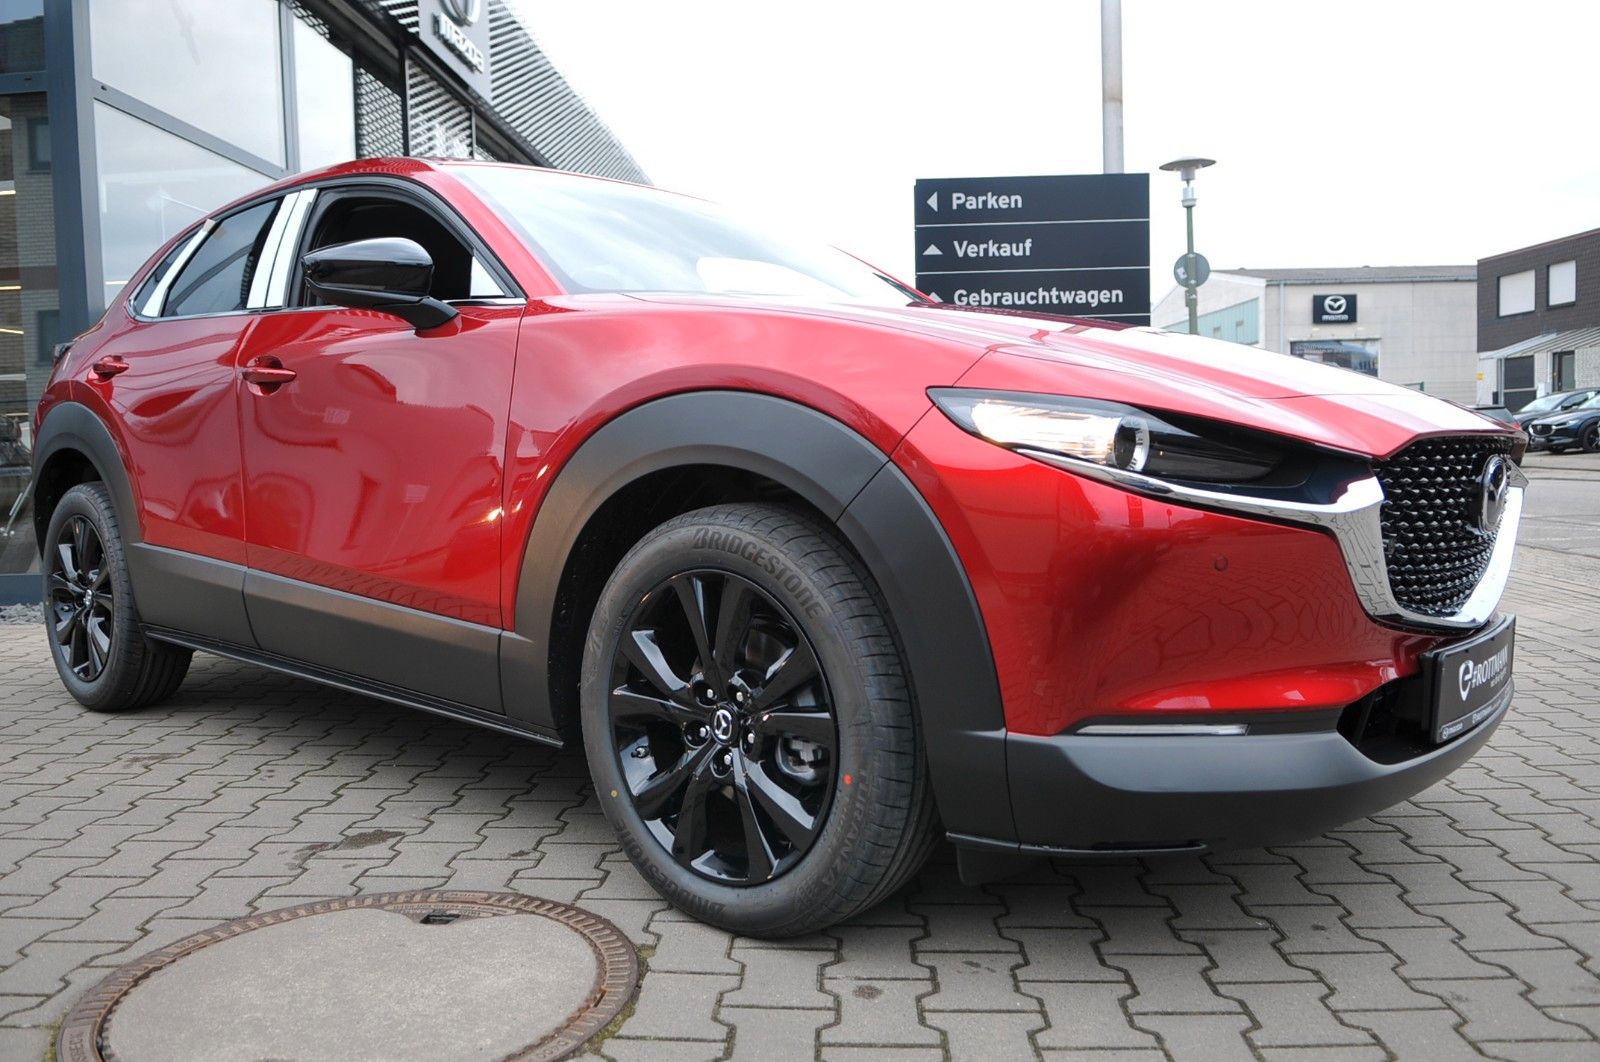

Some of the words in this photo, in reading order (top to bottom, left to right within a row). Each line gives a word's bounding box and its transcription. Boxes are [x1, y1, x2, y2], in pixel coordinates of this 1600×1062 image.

[951, 191, 1023, 210] Parken
[953, 238, 1033, 258] Verkauf
[953, 286, 1124, 307] Gebrauchtwagen
[692, 526, 826, 619] BRIDGESTONE
